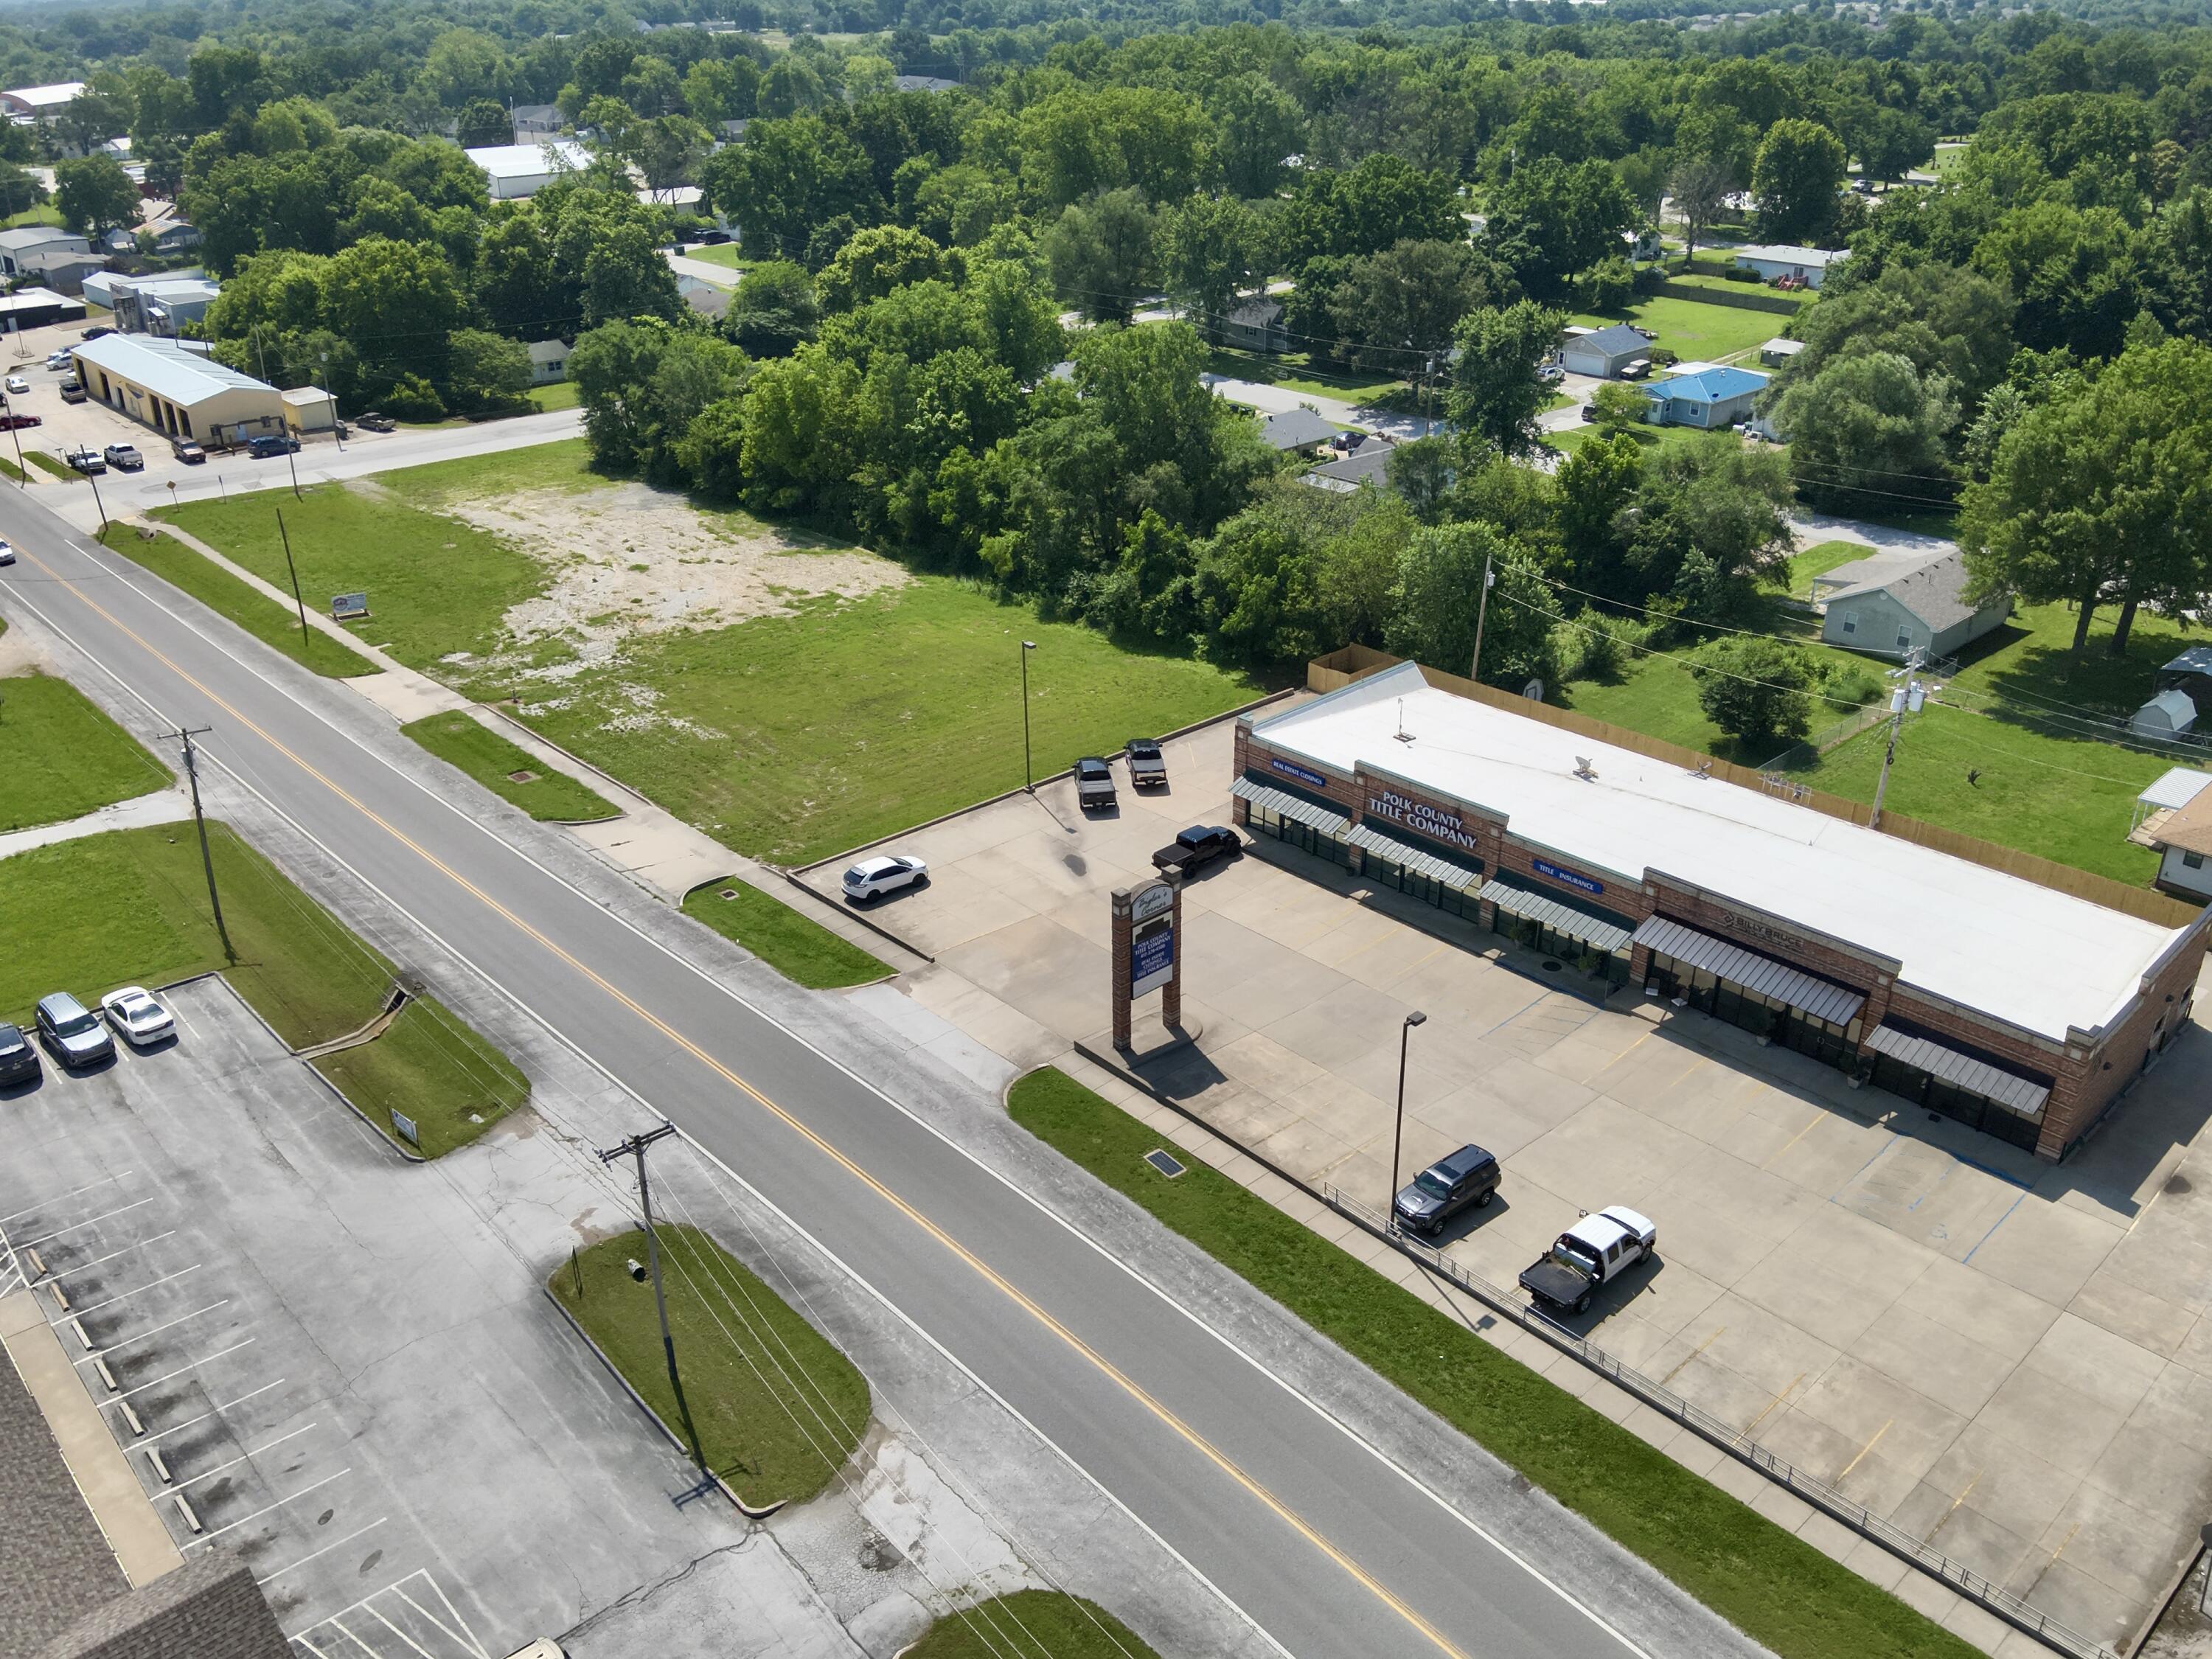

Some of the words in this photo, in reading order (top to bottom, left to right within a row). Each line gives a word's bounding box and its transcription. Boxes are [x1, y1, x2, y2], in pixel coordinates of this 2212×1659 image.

[1273, 761, 1284, 771] REAL
[1284, 765, 1299, 776] ESTATE
[1300, 771, 1322, 785] CLOSINGS
[1369, 798, 1402, 821] TITLE
[1407, 814, 1477, 849] COMPANY
[1383, 791, 1412, 811] POLK
[1415, 804, 1463, 830] COUNTY
[1539, 864, 1554, 875] TITLE
[1559, 872, 1594, 891] INSURANCE
[1147, 936, 1171, 950] COMPANY
[1737, 917, 1764, 931] BILLY
[1765, 928, 1804, 947] BRUCE
